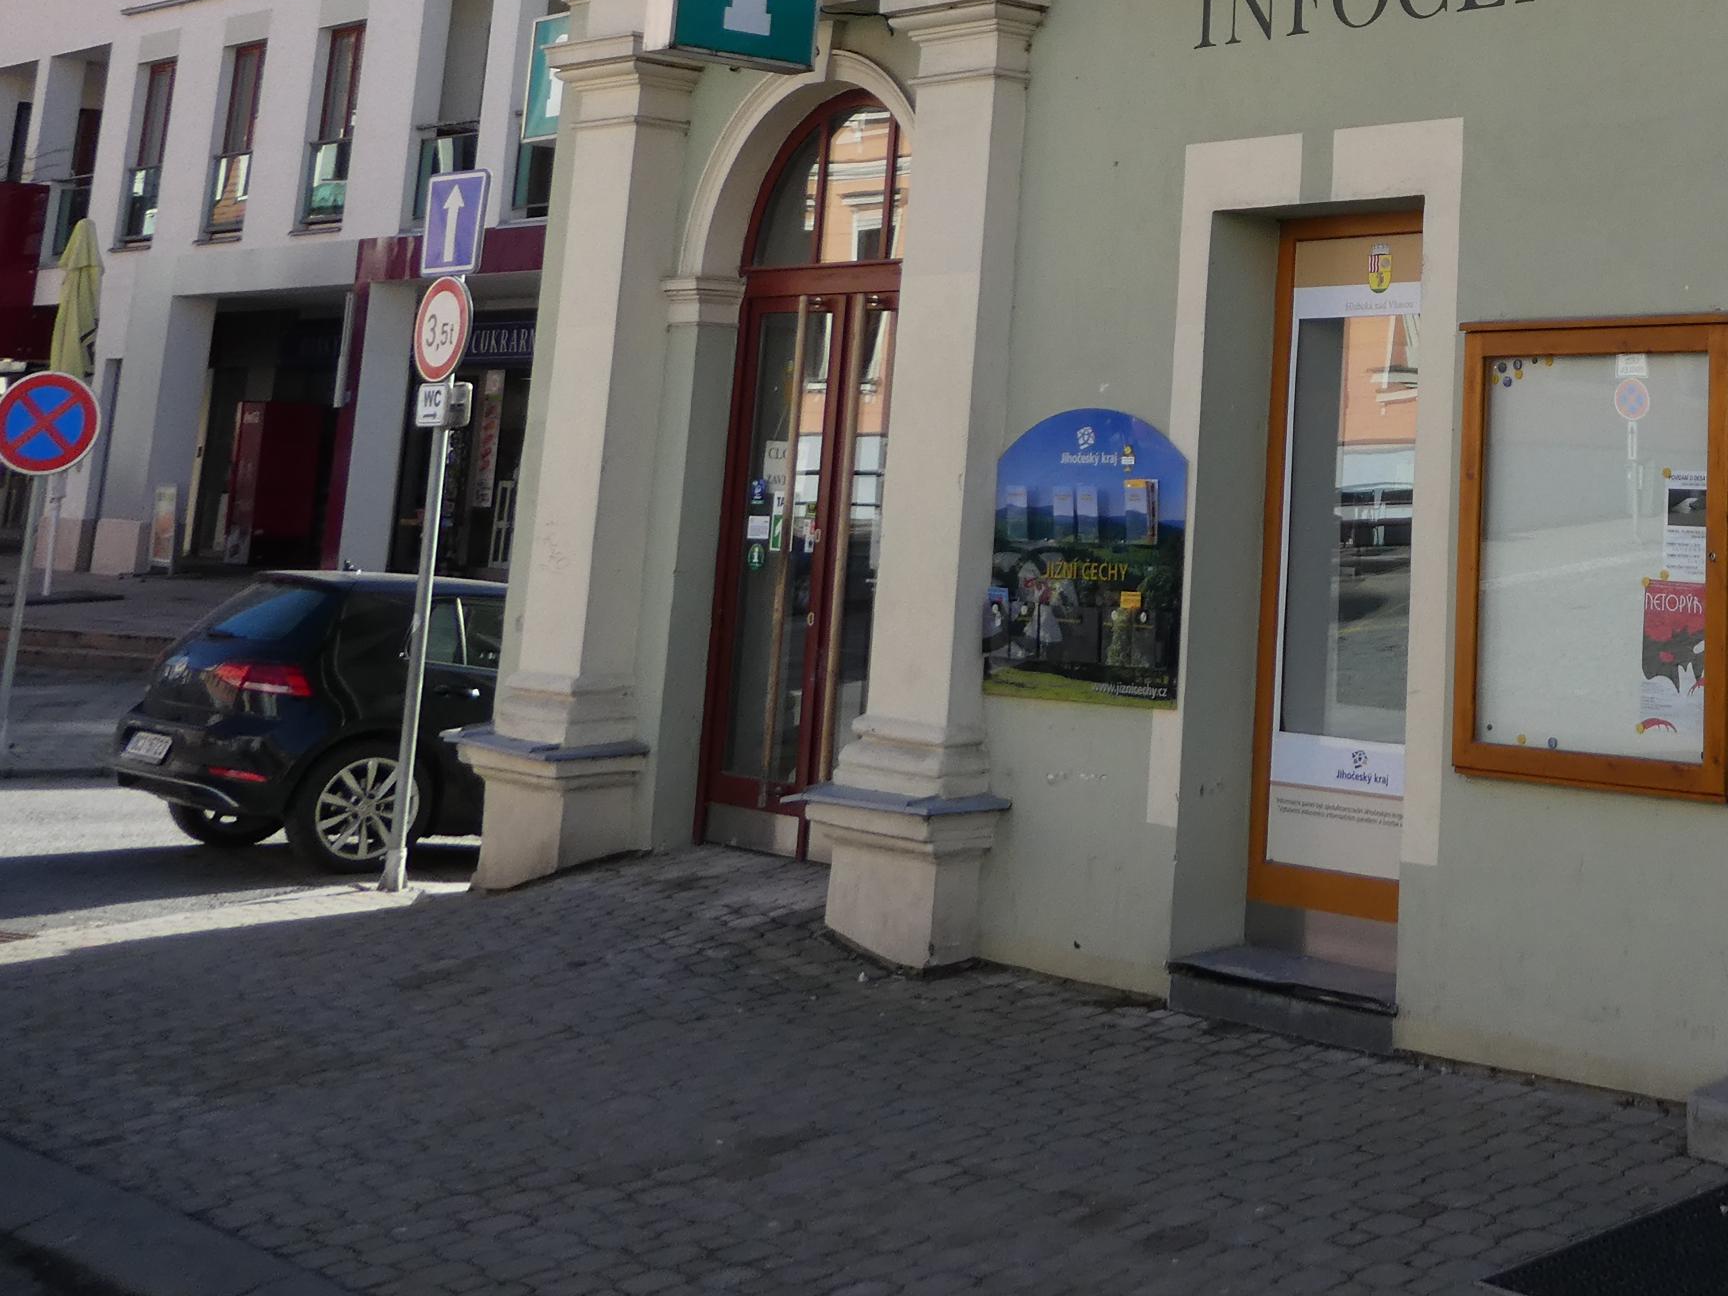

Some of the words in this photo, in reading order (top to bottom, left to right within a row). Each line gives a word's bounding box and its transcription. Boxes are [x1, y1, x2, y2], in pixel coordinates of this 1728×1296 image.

[423, 389, 442, 408] WC
[1060, 452, 1098, 466] Jihočeský
[1101, 451, 1118, 467] kraj
[1045, 558, 1080, 580] JIŽNÍ
[1082, 559, 1129, 582] ČECHY
[1336, 769, 1372, 785] Jihočeský
[1374, 773, 1389, 787] kraj
